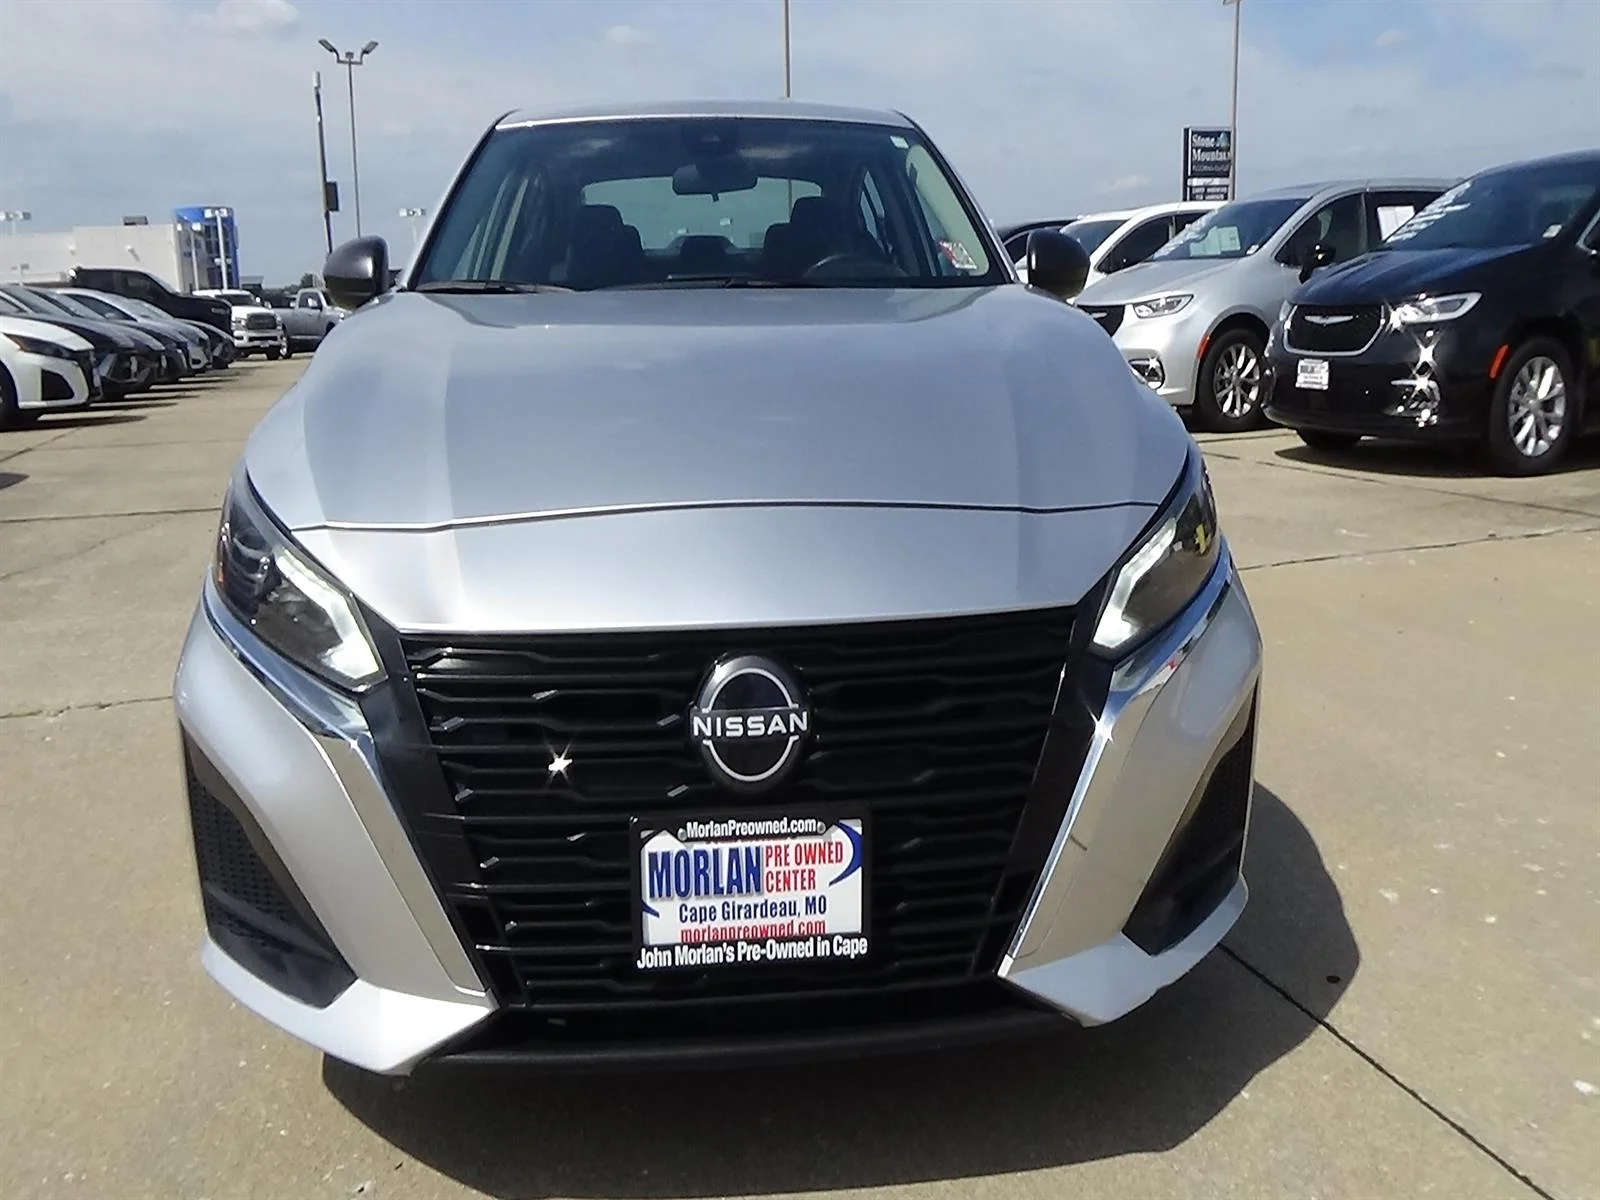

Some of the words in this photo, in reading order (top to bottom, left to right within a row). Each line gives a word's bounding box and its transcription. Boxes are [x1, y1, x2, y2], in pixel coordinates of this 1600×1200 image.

[1192, 133, 1215, 148] Stone
[692, 711, 808, 738] NISSAN
[686, 816, 817, 838] MorlanPreowned.com
[765, 844, 790, 867] PRE
[794, 840, 843, 866] OWNED
[648, 846, 761, 898] MORLAN
[765, 868, 816, 893] CENTER
[679, 903, 717, 924] Cape
[721, 899, 801, 921] Girardeau,
[805, 895, 827, 915] MO
[636, 946, 672, 969] John
[674, 942, 735, 966] Morlan's
[737, 937, 814, 961] Pre-Owned
[816, 936, 830, 957] in
[833, 934, 868, 959] Cape
